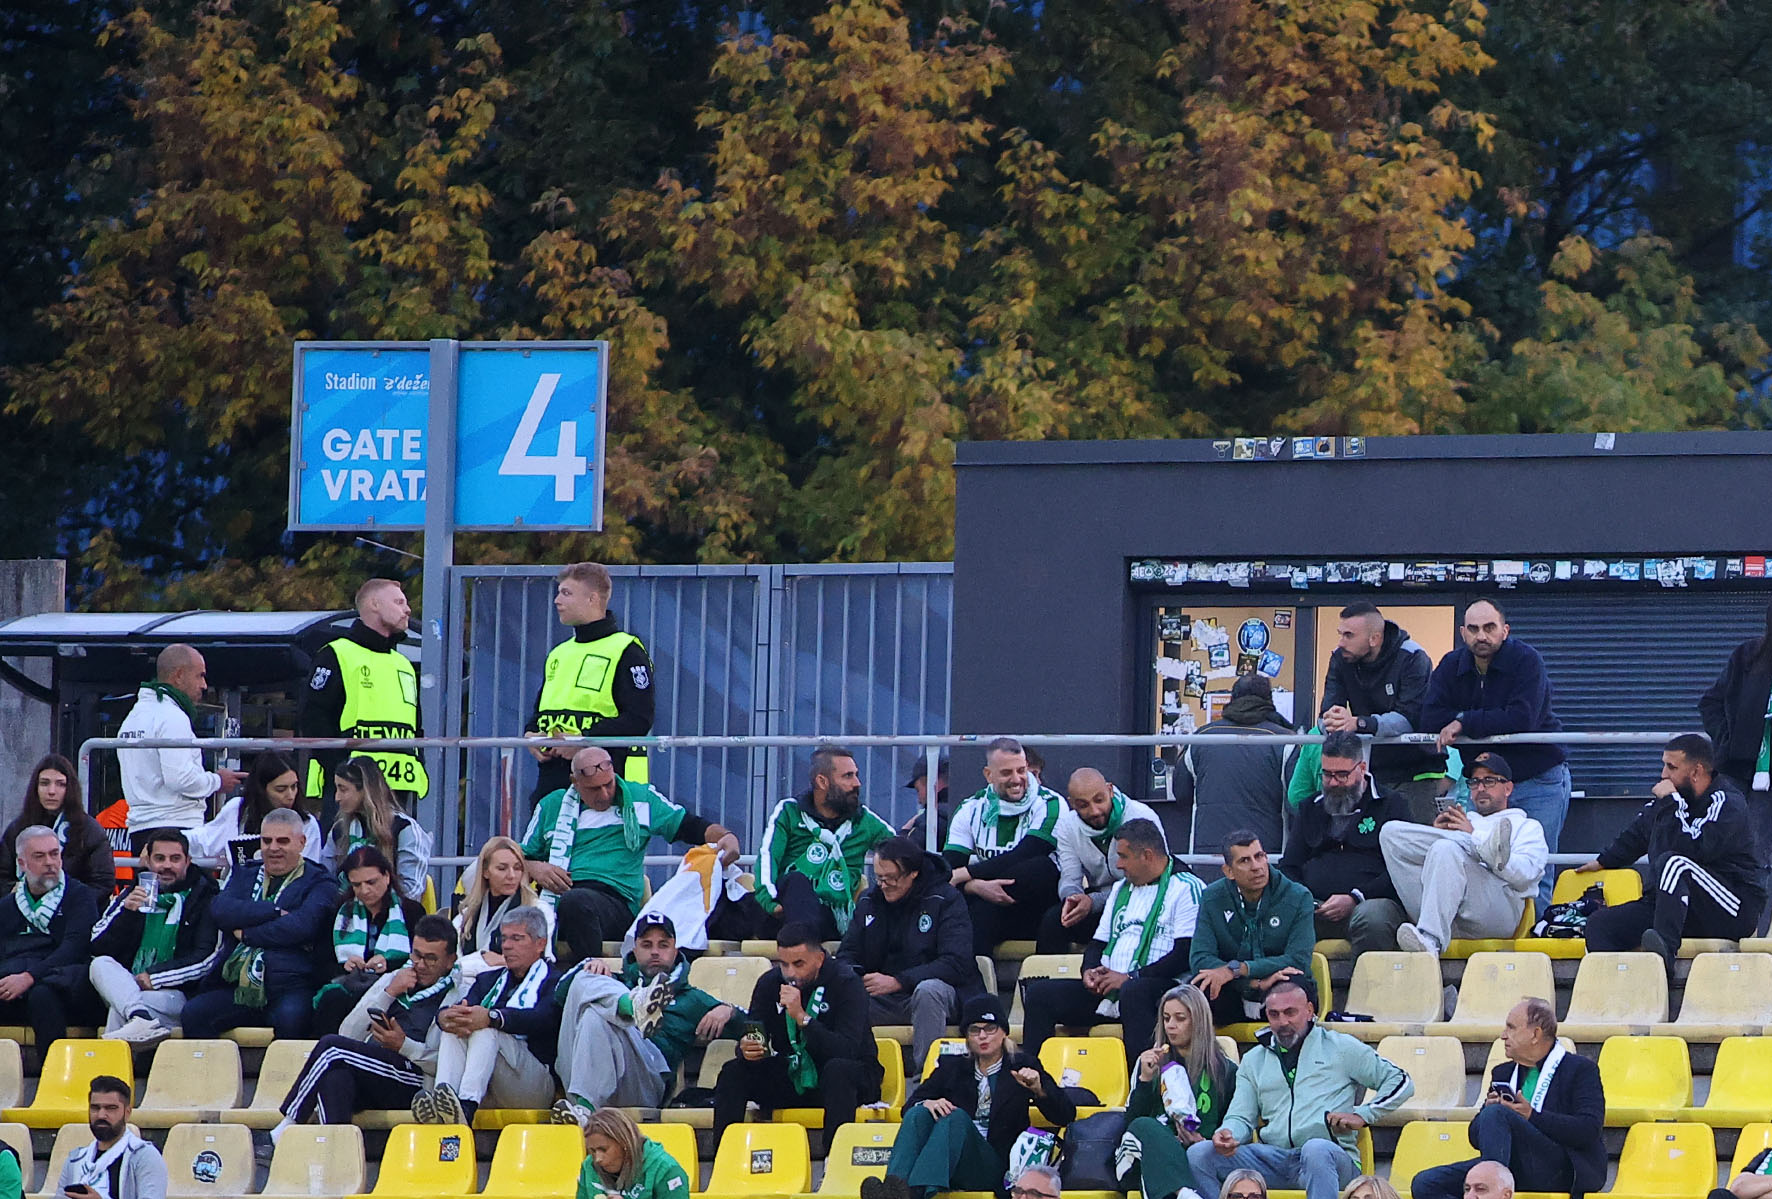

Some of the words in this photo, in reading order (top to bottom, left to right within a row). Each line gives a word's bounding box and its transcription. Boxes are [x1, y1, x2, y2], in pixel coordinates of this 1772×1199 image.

[325, 373, 376, 391] Stadion
[322, 428, 422, 461] GATE
[498, 373, 587, 502] 4
[321, 469, 427, 501] VRAT
